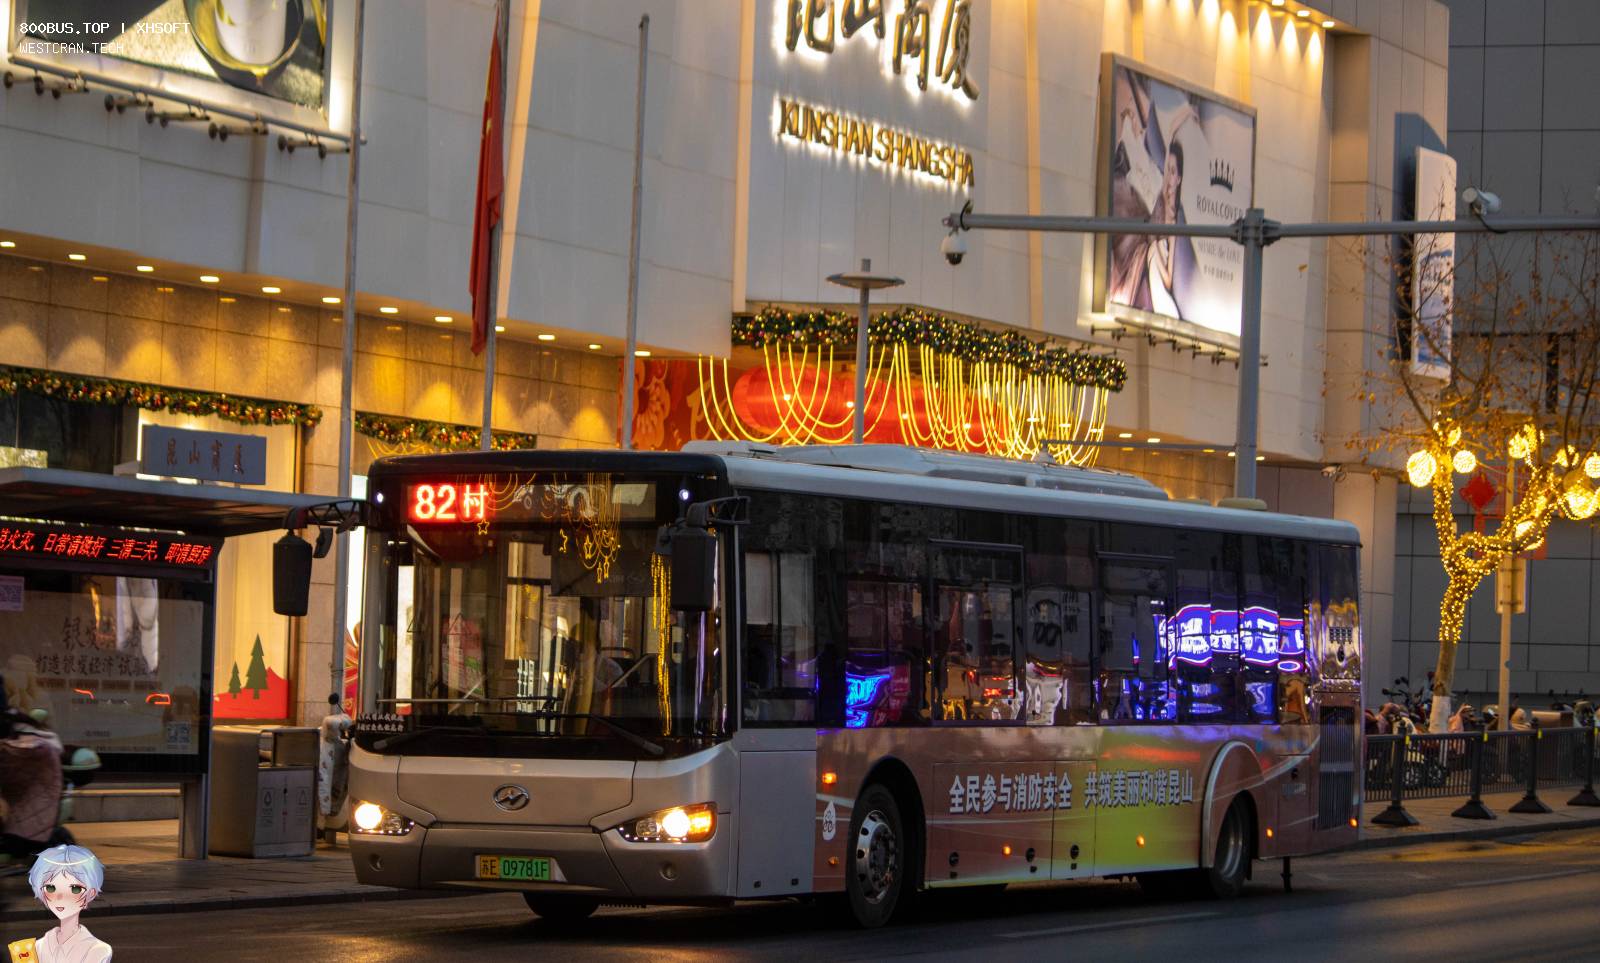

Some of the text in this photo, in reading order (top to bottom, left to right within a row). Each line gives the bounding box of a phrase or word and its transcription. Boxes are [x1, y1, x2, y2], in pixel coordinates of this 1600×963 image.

[778, 99, 975, 188] KUNSHAN SHANGSHA
[415, 484, 457, 520] 82
[948, 769, 1194, 815] 全民参与消防安全 共筑美丽和谐昆山
